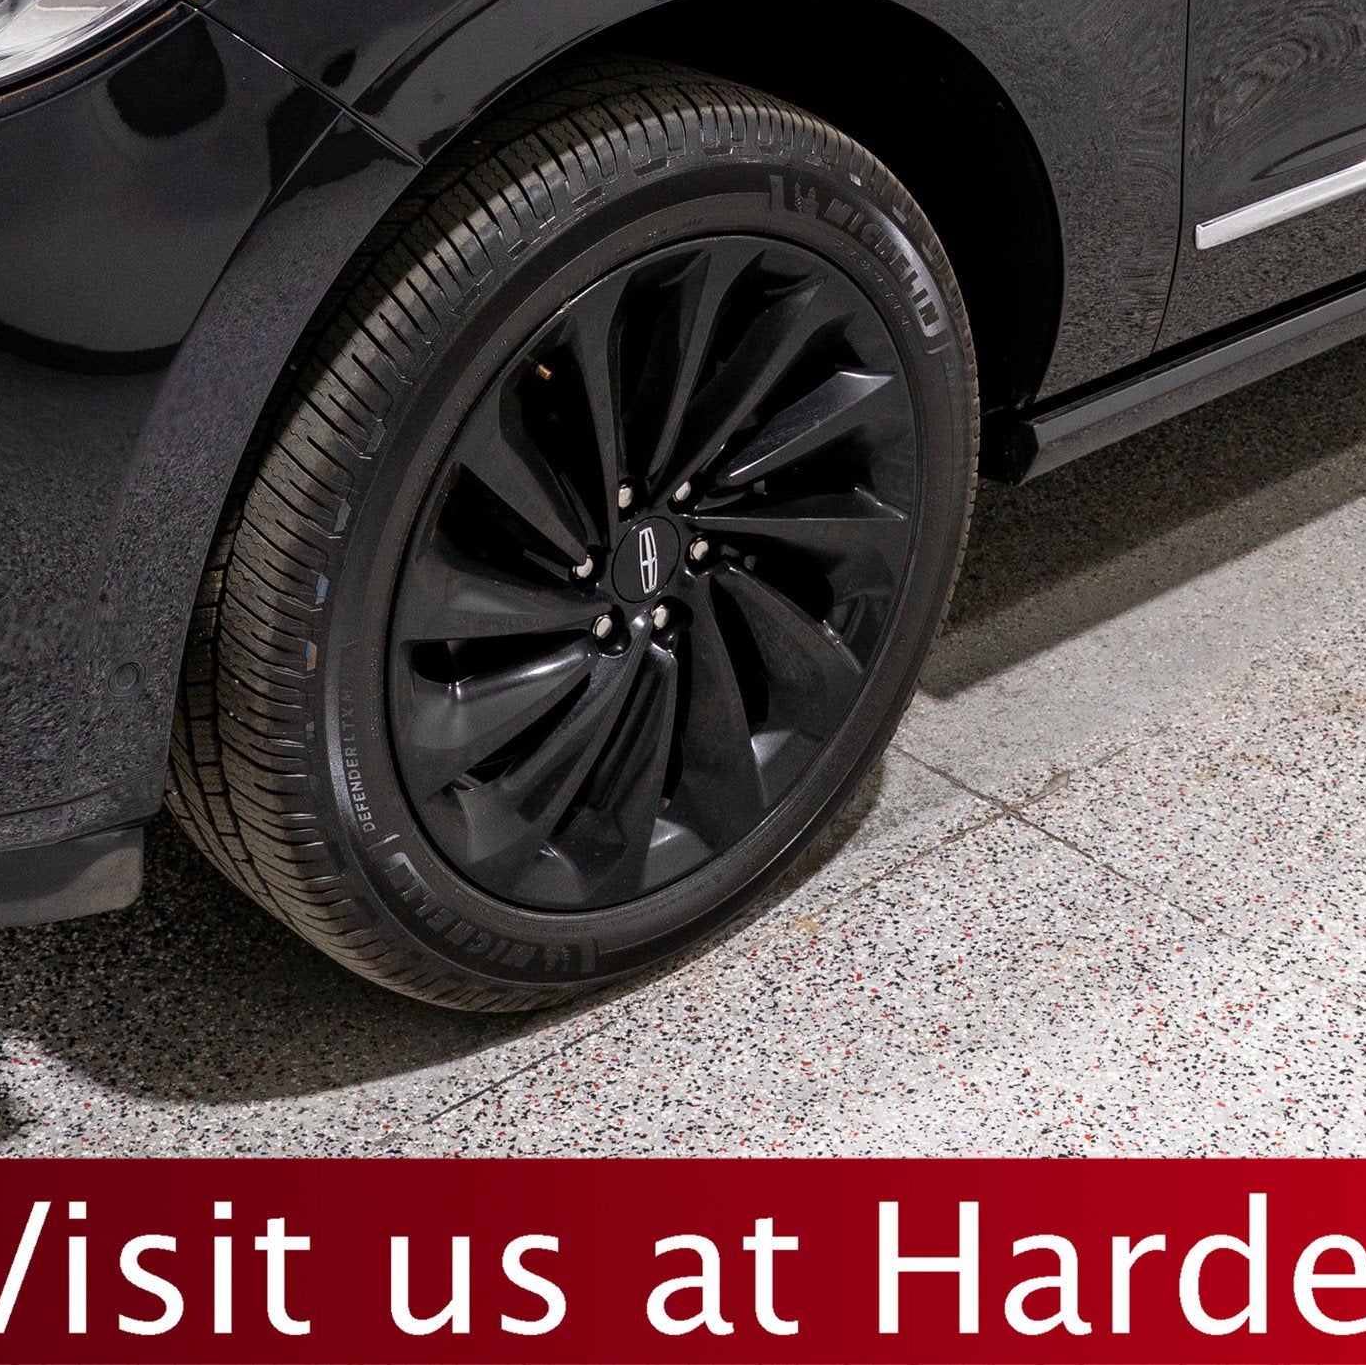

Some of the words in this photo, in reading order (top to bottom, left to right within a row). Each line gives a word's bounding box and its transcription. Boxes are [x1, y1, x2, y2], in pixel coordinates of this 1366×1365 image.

[823, 197, 941, 327] MICHELIN
[340, 707, 356, 742] LTX
[342, 746, 377, 833] DEFENDER
